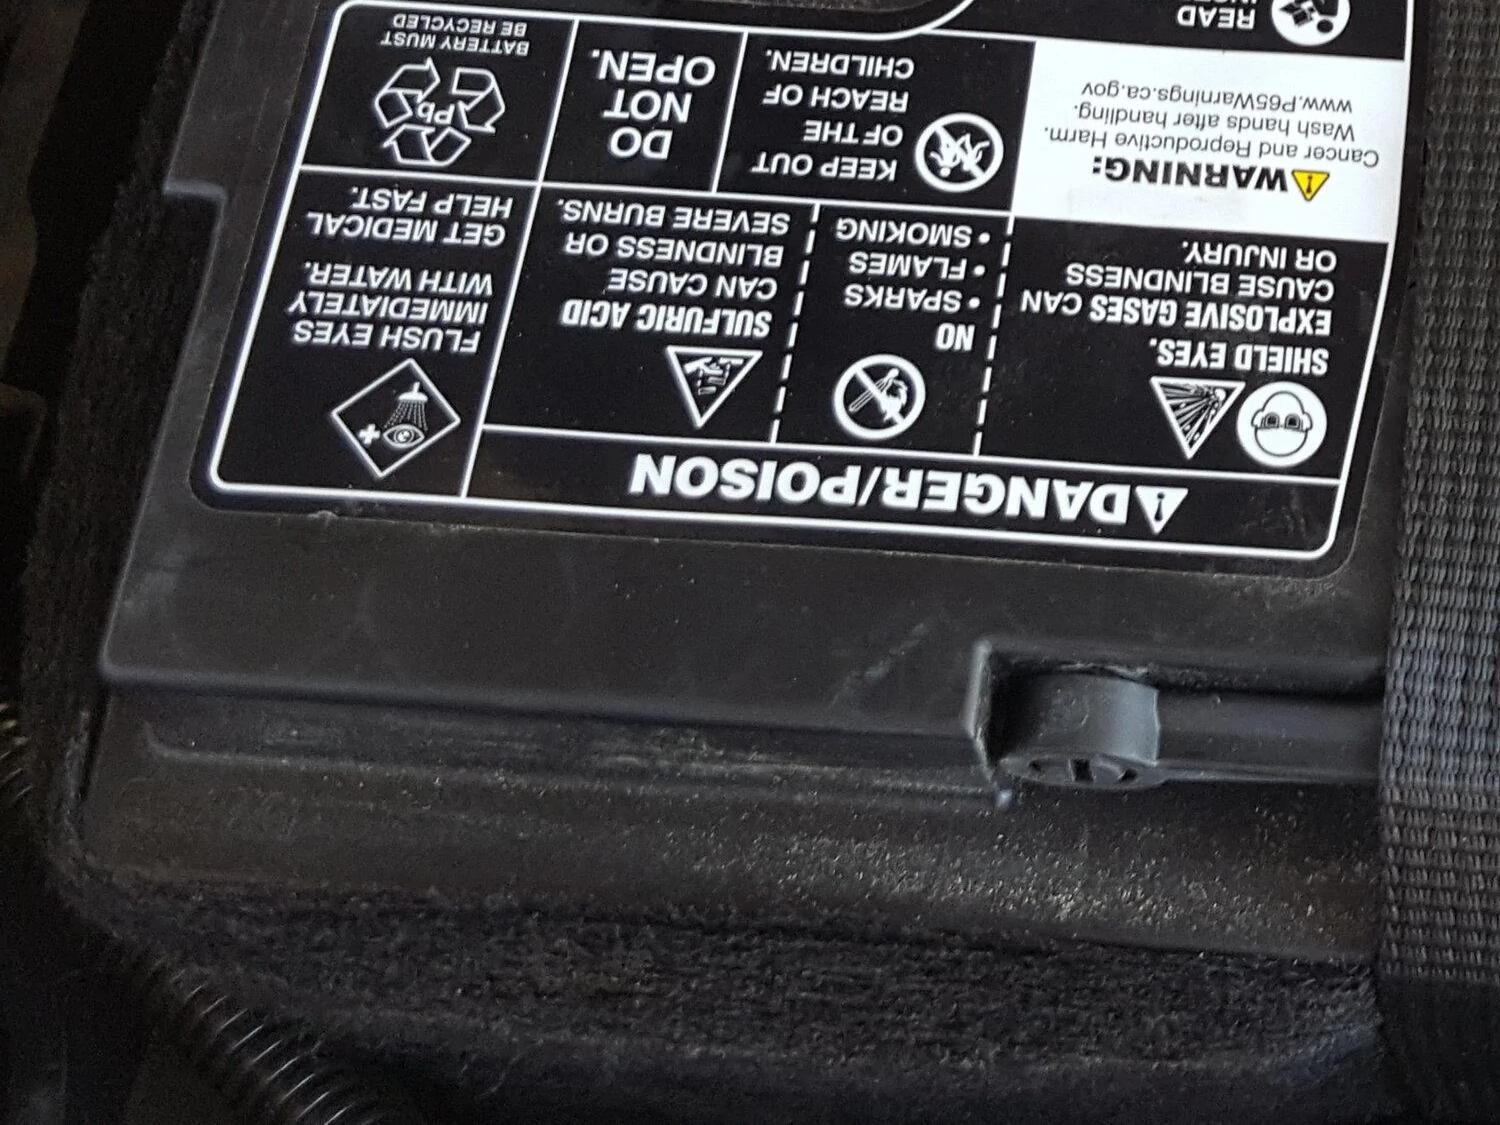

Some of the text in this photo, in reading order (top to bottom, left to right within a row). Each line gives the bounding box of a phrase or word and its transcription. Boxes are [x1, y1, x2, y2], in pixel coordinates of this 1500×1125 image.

[392, 13, 528, 38] BE RECYCLED
[1177, 5, 1256, 30] READ
[380, 31, 530, 57] BATTERY MUST
[592, 49, 716, 87] OPEN.
[766, 50, 915, 80] CHILDREN.
[416, 99, 456, 125] Pb
[603, 89, 693, 124] NOT
[762, 84, 910, 113] REACH OF
[1081, 80, 1353, 114] www.P65Warnings.ca.gov
[803, 120, 904, 147] OF THE
[1074, 101, 1356, 143] Wash hands after handling.
[609, 127, 674, 160] DO
[1044, 127, 1380, 169] Cancer and Reproductive Harm.
[751, 152, 898, 182] KEEP OUT
[1092, 156, 1288, 193] WARNING:
[352, 187, 514, 218] HELP FAST.
[558, 199, 791, 236] SEVERE BURNS.
[308, 212, 506, 247] GET MEDICAL
[836, 218, 973, 248] SMOKING
[564, 232, 785, 268] BLINDNESS OR
[849, 251, 968, 281] FLAMES
[1182, 241, 1337, 272] OR INJURY.
[305, 262, 493, 296] WITH WATER.
[607, 268, 778, 301] CAN CAUSE
[1066, 263, 1335, 302] CAUSE BLINDNESS
[288, 290, 489, 325] IMMEDIATELY
[844, 284, 963, 314] SPARKS
[1020, 290, 1333, 336] EXPLOSIVE GASES CAN
[561, 299, 773, 339] SULFURIC ACID
[293, 320, 482, 354] FLUSH EYES
[935, 323, 976, 352] NO
[1149, 338, 1330, 376] SHIELD EYES.
[628, 451, 1133, 525] DANGER/POISON
